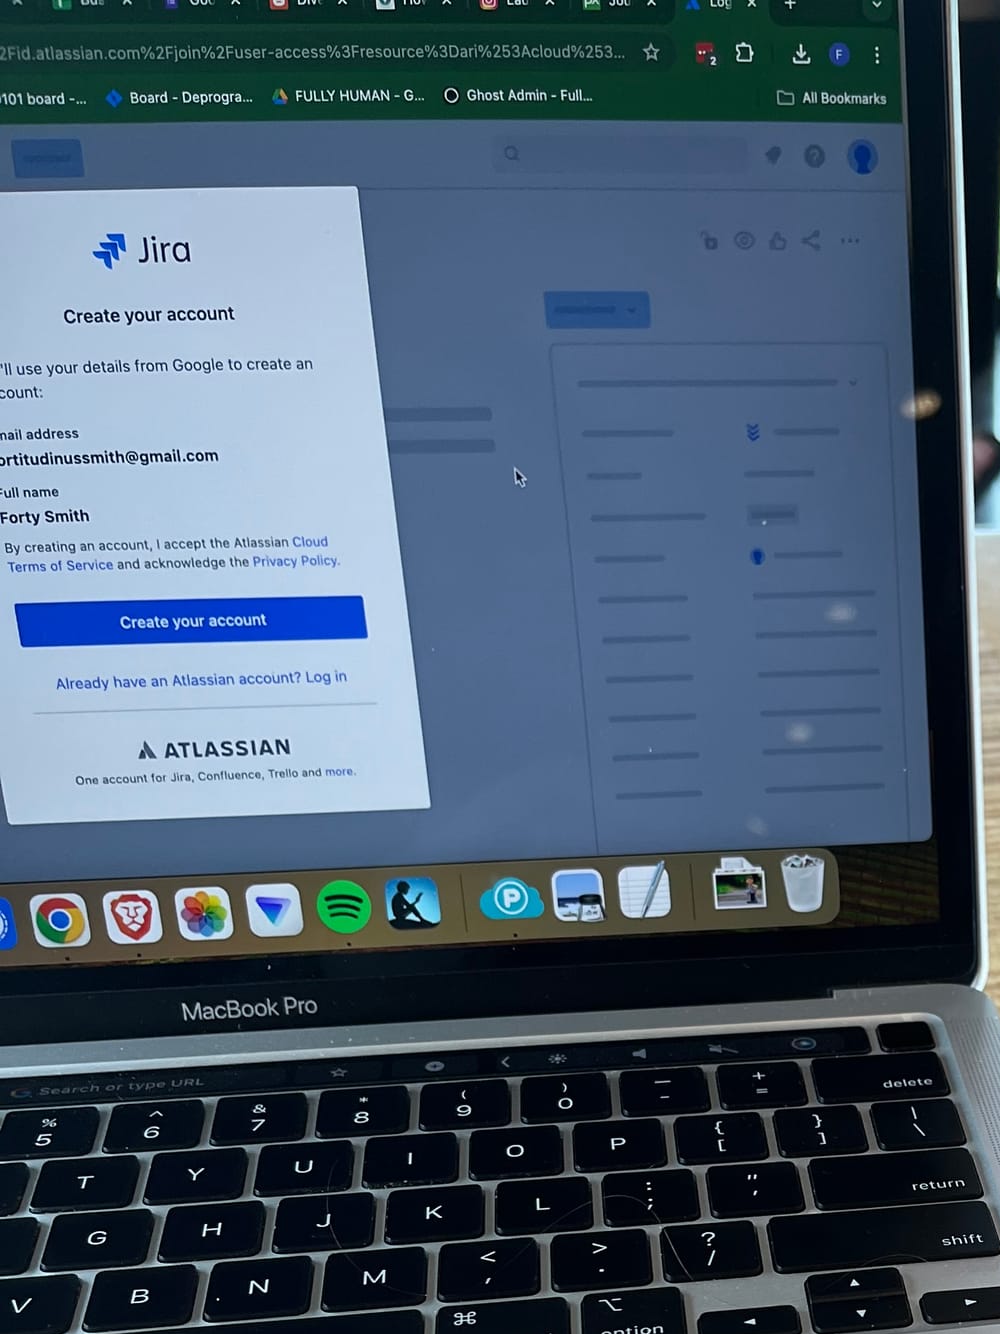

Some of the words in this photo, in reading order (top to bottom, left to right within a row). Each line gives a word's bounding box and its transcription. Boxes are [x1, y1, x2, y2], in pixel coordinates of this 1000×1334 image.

[835, 49, 842, 60] F
[27, 93, 65, 104] board
[130, 91, 167, 103] Board
[296, 90, 335, 101] FULLY
[340, 90, 389, 101] HUMAN
[467, 89, 504, 101] Ghost
[508, 89, 547, 100] Admin
[803, 92, 817, 103] All
[821, 92, 886, 104] Bookmarks
[139, 236, 190, 263] Jira
[64, 309, 120, 323] Create
[125, 311, 162, 325] your
[168, 307, 234, 321] account
[17, 365, 42, 375] use
[47, 364, 78, 377] your
[83, 360, 130, 373] details
[135, 360, 168, 372] from
[173, 358, 223, 373] Google
[228, 359, 242, 370] to
[247, 359, 291, 370] create
[297, 360, 312, 369] an
[27, 428, 79, 440] address
[0, 449, 218, 466] ortitudinussmith@gmail.com
[23, 489, 58, 497] name
[0, 512, 40, 526] Forty
[45, 509, 89, 522] Smith
[5, 543, 20, 555] By
[25, 541, 76, 553] creating
[80, 543, 94, 551] an
[99, 540, 152, 551] account,
[165, 539, 206, 551] accept
[210, 538, 229, 548] the
[235, 536, 288, 548] Atlassian
[293, 536, 328, 547] Cloud
[8, 562, 46, 572] Terms
[51, 561, 62, 571] of
[67, 560, 113, 571] Service
[118, 558, 140, 569] and
[145, 557, 225, 569] acknowledge
[230, 557, 249, 567] the
[253, 556, 297, 568] Privacy
[301, 555, 340, 568] Policy.
[120, 616, 168, 629] Create
[173, 618, 204, 630] your
[209, 614, 267, 626] account
[57, 677, 108, 691] Already
[113, 676, 146, 688] have
[151, 678, 168, 687] an
[173, 674, 234, 686] Atlassian
[240, 672, 301, 685] account?
[306, 672, 331, 685] Log
[335, 671, 347, 681] in
[165, 739, 290, 758] ATLASSIAN
[76, 776, 98, 785] One
[103, 774, 147, 784] account
[151, 773, 165, 782] for
[171, 773, 194, 782] Jira,
[198, 771, 264, 781] Confluence,
[268, 769, 298, 778] Trello
[302, 768, 321, 777] and
[182, 998, 279, 1021] MacBook
[284, 997, 317, 1014] Pro
[39, 1082, 100, 1097] Search
[105, 1082, 124, 1093] or
[128, 1079, 166, 1093] type
[171, 1077, 205, 1090] URL
[883, 1079, 932, 1088] delete
[558, 1098, 573, 1109] 0
[457, 1105, 471, 1116] 9
[354, 1112, 369, 1123] 8
[252, 1119, 265, 1131] 7
[144, 1126, 159, 1138] 6
[35, 1134, 52, 1146] 5
[611, 1138, 625, 1150] P
[507, 1145, 524, 1157] O
[295, 1160, 313, 1173] U
[188, 1168, 204, 1180] Y
[78, 1176, 94, 1189] T
[913, 1180, 965, 1190] return
[536, 1198, 550, 1210] L
[426, 1206, 442, 1219] K
[317, 1214, 330, 1227] J
[202, 1223, 222, 1237] H
[88, 1231, 106, 1245] G
[942, 1234, 983, 1245] shift
[364, 1270, 386, 1285] M
[249, 1279, 269, 1294] N
[131, 1289, 148, 1304] B
[12, 1298, 32, 1313] V
